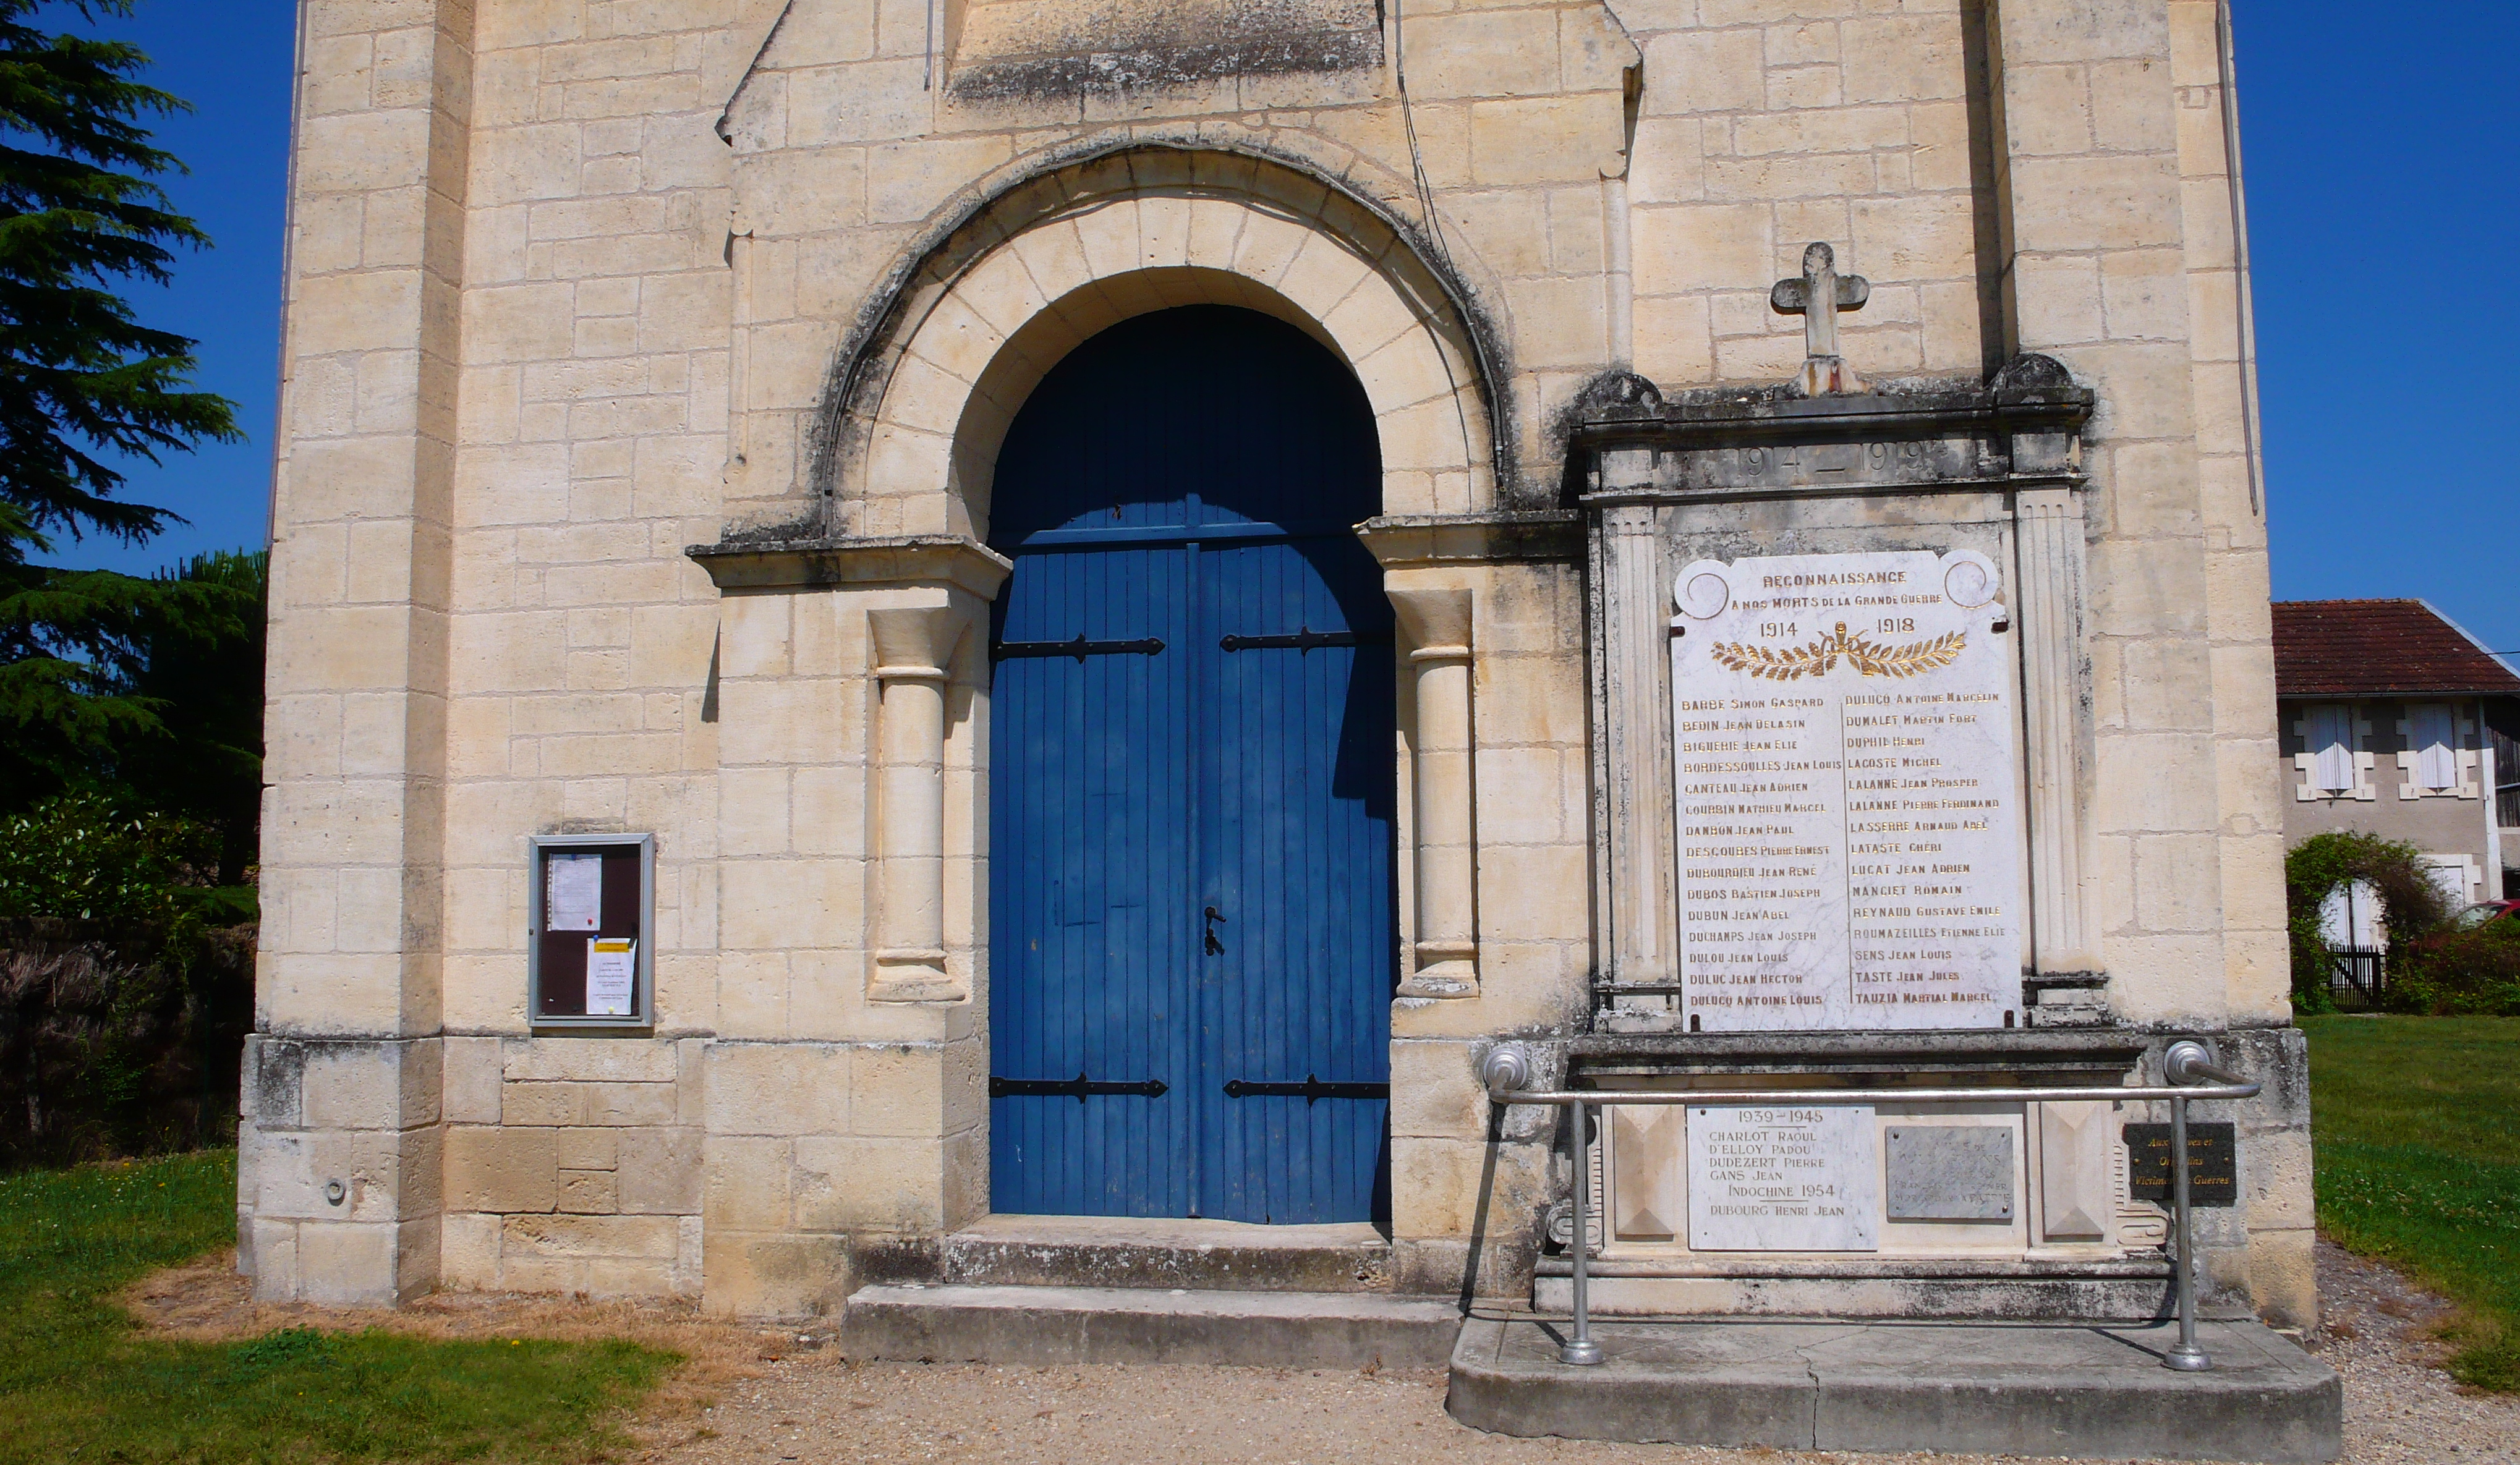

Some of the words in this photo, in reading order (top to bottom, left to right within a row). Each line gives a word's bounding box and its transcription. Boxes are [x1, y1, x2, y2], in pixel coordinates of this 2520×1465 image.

[1763, 571, 1907, 587] RECONNAISSANCE
[1743, 600, 1767, 609] NOS
[1773, 597, 1818, 608] MORTS
[1823, 597, 1834, 606] DE
[1838, 597, 1850, 606] LA
[1855, 595, 1898, 606] GRANDE
[1901, 594, 1943, 605] GUERRE
[1761, 622, 1798, 638] 1914
[1878, 618, 1915, 634] 1918
[1682, 700, 1725, 711] BARBE
[1731, 699, 1764, 710] SIMON
[1771, 697, 1823, 709] GASPARD
[1896, 694, 1943, 705] ANTOINE
[1947, 693, 1999, 703] MARCELIN
[1904, 715, 1944, 725] MARTIN
[1949, 714, 1977, 723] FORT
[1683, 721, 1719, 732] BEDIN
[1724, 720, 1752, 731] JEAN
[1684, 741, 1739, 753] BIGUERIE
[1743, 742, 1771, 751] JEAN
[1775, 741, 1797, 750] ELIE
[1847, 737, 1889, 749] DUPHIL
[1893, 736, 1924, 747] HENRI
[1684, 761, 1781, 773] BORDESSOULLES
[1784, 760, 1809, 771] JEAN
[1813, 760, 1842, 770] LOUIS
[1848, 758, 1896, 769] LACOSTE
[1902, 758, 1942, 768] MICHEL
[1685, 784, 1736, 795] CANTEAU
[1740, 783, 1766, 793] JEAN
[1770, 783, 1808, 792] ADRIEN
[1849, 779, 1897, 790] LALANNE
[1901, 779, 1927, 789] JEAN
[1931, 778, 1978, 788] PROSPER
[1686, 804, 1734, 815] COURBIN
[1739, 804, 1781, 815] MATHIEU
[1785, 803, 1826, 813] MARCEL
[1850, 800, 1897, 812] LALANNE
[1903, 800, 1939, 810] PIERRE
[1943, 799, 1999, 810] FERDINAND
[1735, 826, 1762, 836] JEAN
[1766, 825, 1794, 834] PAUL
[1850, 822, 1910, 833] LASSERRE
[1914, 821, 1957, 831] ARNAUD
[1963, 820, 1988, 831] ABEL
[1687, 846, 1757, 859] DESCOUBES
[1761, 846, 1793, 856] PIERRE
[1795, 846, 1829, 856] ERNEST
[1852, 843, 1901, 854] LATASTE
[1687, 868, 1754, 879] DUBOURDIEU
[1758, 867, 1785, 877] JEAN
[1852, 865, 1891, 876] LUCAT
[1896, 864, 1925, 875] JEAN
[1931, 864, 1970, 874] ADRIEN
[1688, 890, 1727, 899] DUBOS
[1732, 889, 1776, 900] BASTIEN
[1779, 888, 1820, 899] JOSEPH
[1853, 886, 1906, 897] MANCIET
[1915, 885, 1962, 895] ROMAIN
[1688, 910, 1728, 921] DUBUN
[1732, 910, 1758, 920] JEAN
[1762, 909, 1789, 919] ABEL
[1854, 907, 1910, 919] REYNAUD
[1917, 907, 1966, 917] GUSTAVE
[1970, 906, 2001, 915] EMILE
[1689, 932, 1744, 942] DUCHAMPS
[1748, 932, 1773, 941] JEAN
[1777, 930, 1816, 941] JOSEPH
[1855, 928, 1936, 939] ROUMAZEILLES
[1941, 928, 1980, 937] ETIENNE
[1984, 927, 2005, 936] ELIE
[1690, 953, 1724, 963] DULOU
[1728, 953, 1753, 962] JEAN
[1757, 952, 1789, 962] LOUIS
[1855, 950, 1884, 960] SENS
[1888, 950, 1915, 959] JEAN
[1921, 949, 1952, 959] LOUIS
[1690, 974, 1726, 985] DULUC
[1729, 974, 1756, 984] JEAN
[1761, 974, 1802, 983] HECTOR
[1856, 972, 1892, 982] TASTE
[1897, 972, 1923, 982] JEAN
[1929, 970, 1960, 980] JULES
[1691, 995, 1731, 1008] DULUCQ
[1737, 995, 1786, 1006] ANTOINE
[1790, 995, 1822, 1005] LOUIS
[1856, 993, 1897, 1004] TAUZIA
[1904, 993, 1947, 1003] MARTIAL
[1951, 992, 1992, 1002] MARCEL
[1709, 1131, 1769, 1141] CHARLOT
[1778, 1131, 1816, 1141] RAOUL
[1772, 1144, 1811, 1155] PADOU
[1710, 1158, 1776, 1167] DUDEZERT
[1784, 1158, 1824, 1167] PIERRE
[1710, 1171, 1745, 1181] GANS
[1752, 1171, 1782, 1181] JEAN
[2194, 1174, 2231, 1186] Guerres
[1729, 1184, 1794, 1197] INDOCHINE
[1802, 1184, 1835, 1197] 1954
[1711, 1205, 1768, 1215] DUBOURG
[1776, 1206, 1808, 1215] HENRI
[1814, 1205, 1844, 1215] JEAN
